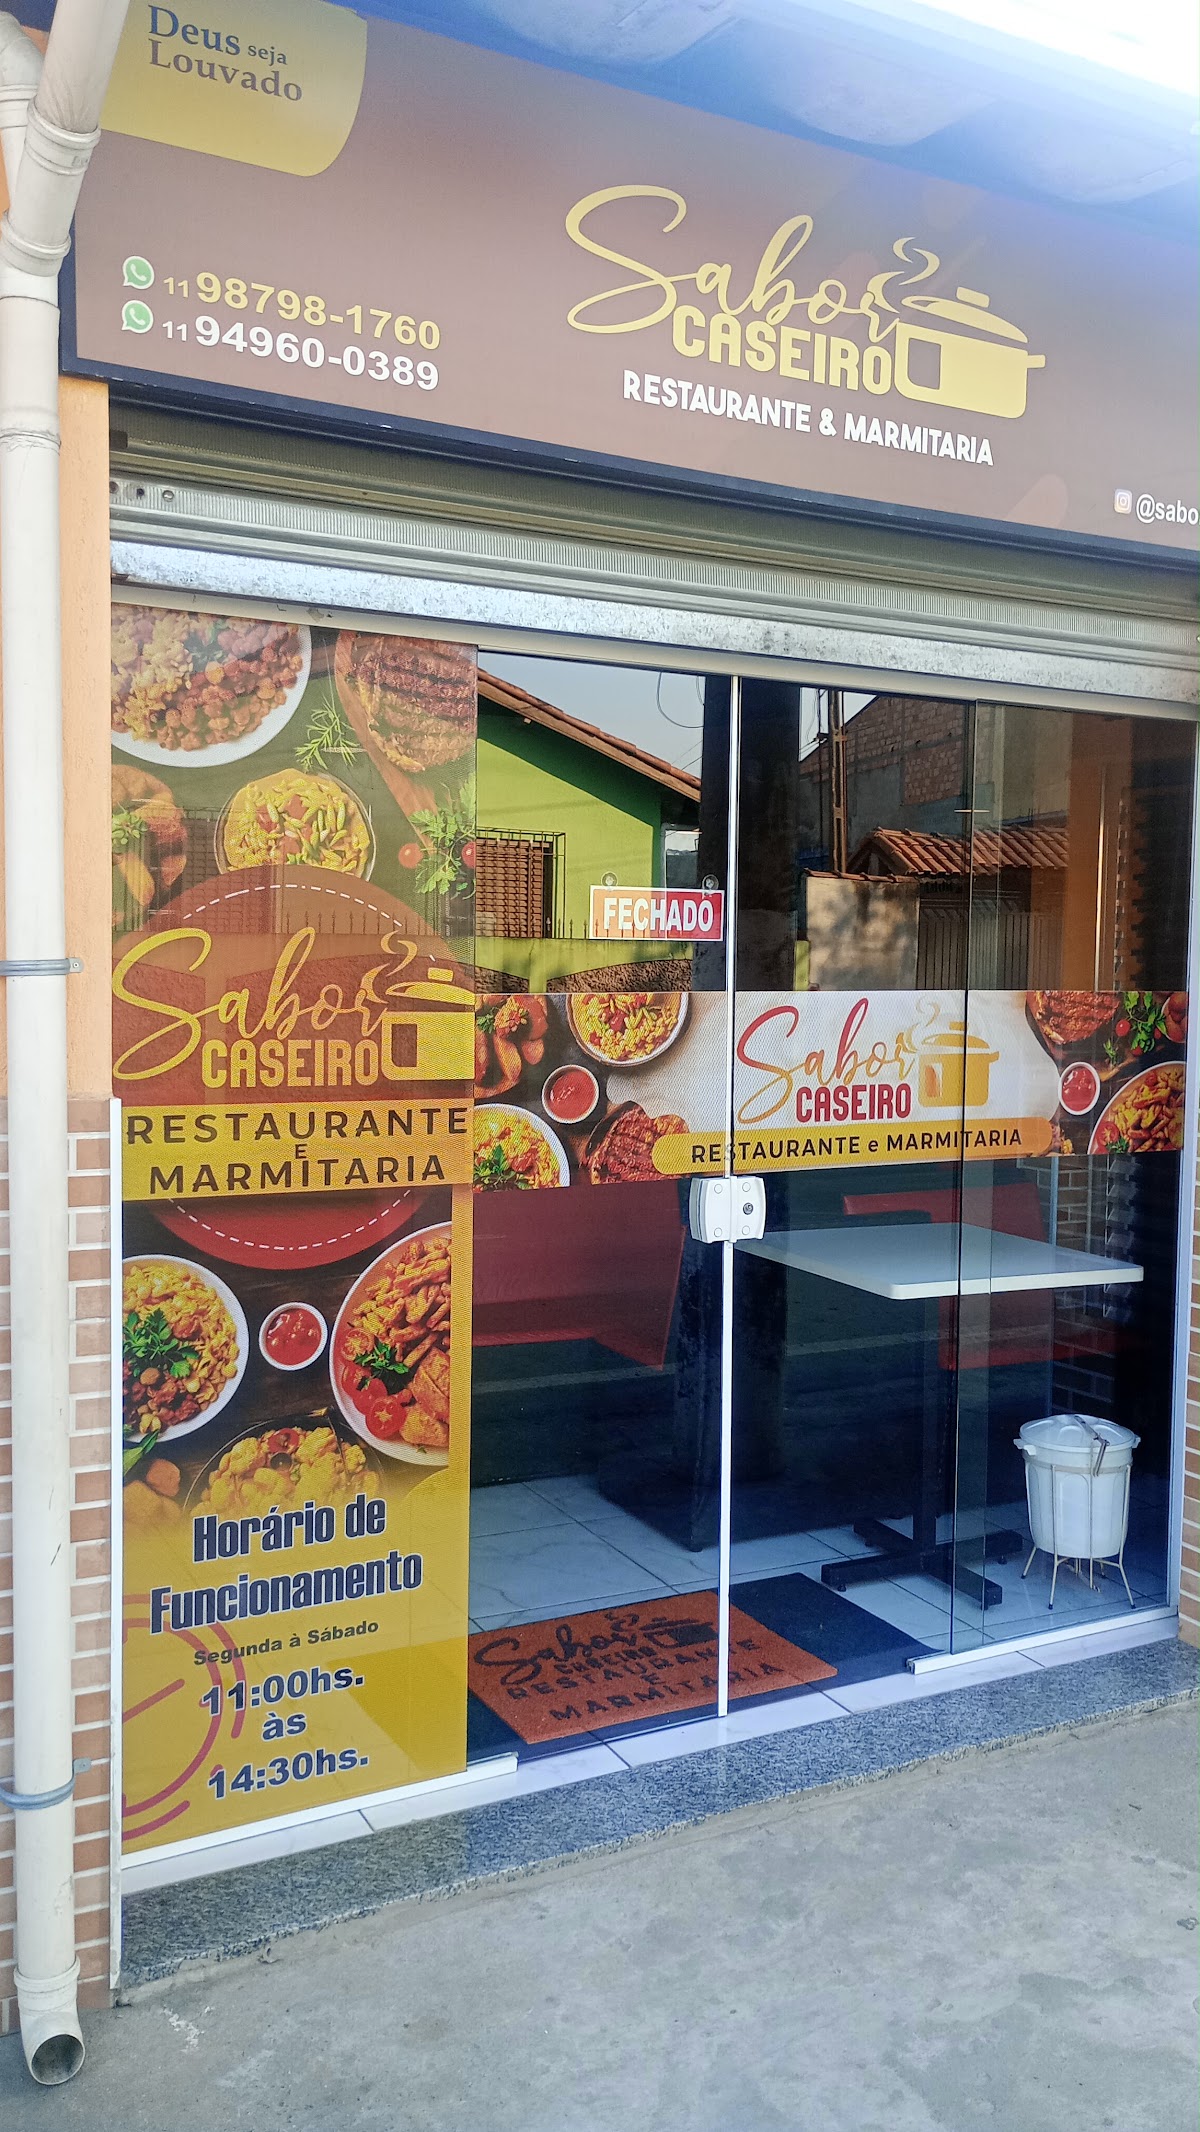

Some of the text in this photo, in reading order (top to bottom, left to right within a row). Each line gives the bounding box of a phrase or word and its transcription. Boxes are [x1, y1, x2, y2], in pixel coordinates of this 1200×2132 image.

[148, 4, 288, 66] Deus seja
[148, 38, 303, 102] Louvado
[565, 184, 902, 342] Sabor
[163, 271, 441, 350] 11 98798-1760
[161, 315, 440, 391] 11 94960-0389
[672, 304, 893, 396] CASEIRO
[622, 369, 995, 467] RESTAURANTE & MARMITARIA
[1136, 493, 1200, 525] @sabo
[603, 896, 714, 932] FECHADO
[112, 926, 386, 1081] Sabor
[201, 1038, 380, 1089] CASEIRO
[736, 998, 915, 1124] Sabor
[126, 1106, 469, 1145] RESTAURANTE
[795, 1082, 912, 1123] CASEIRO
[294, 1143, 308, 1159] E
[691, 1128, 1023, 1164] RESTAURANTE e MARMITARIA
[149, 1154, 446, 1195] MARMITARIA
[192, 1493, 387, 1563] Horário de
[149, 1550, 424, 1635] Funcionamento
[194, 1619, 380, 1666] Segunda à Sábado
[200, 1664, 365, 1717] 11:00hs.
[261, 1712, 307, 1741] às
[207, 1744, 370, 1799] 14:30hs.
